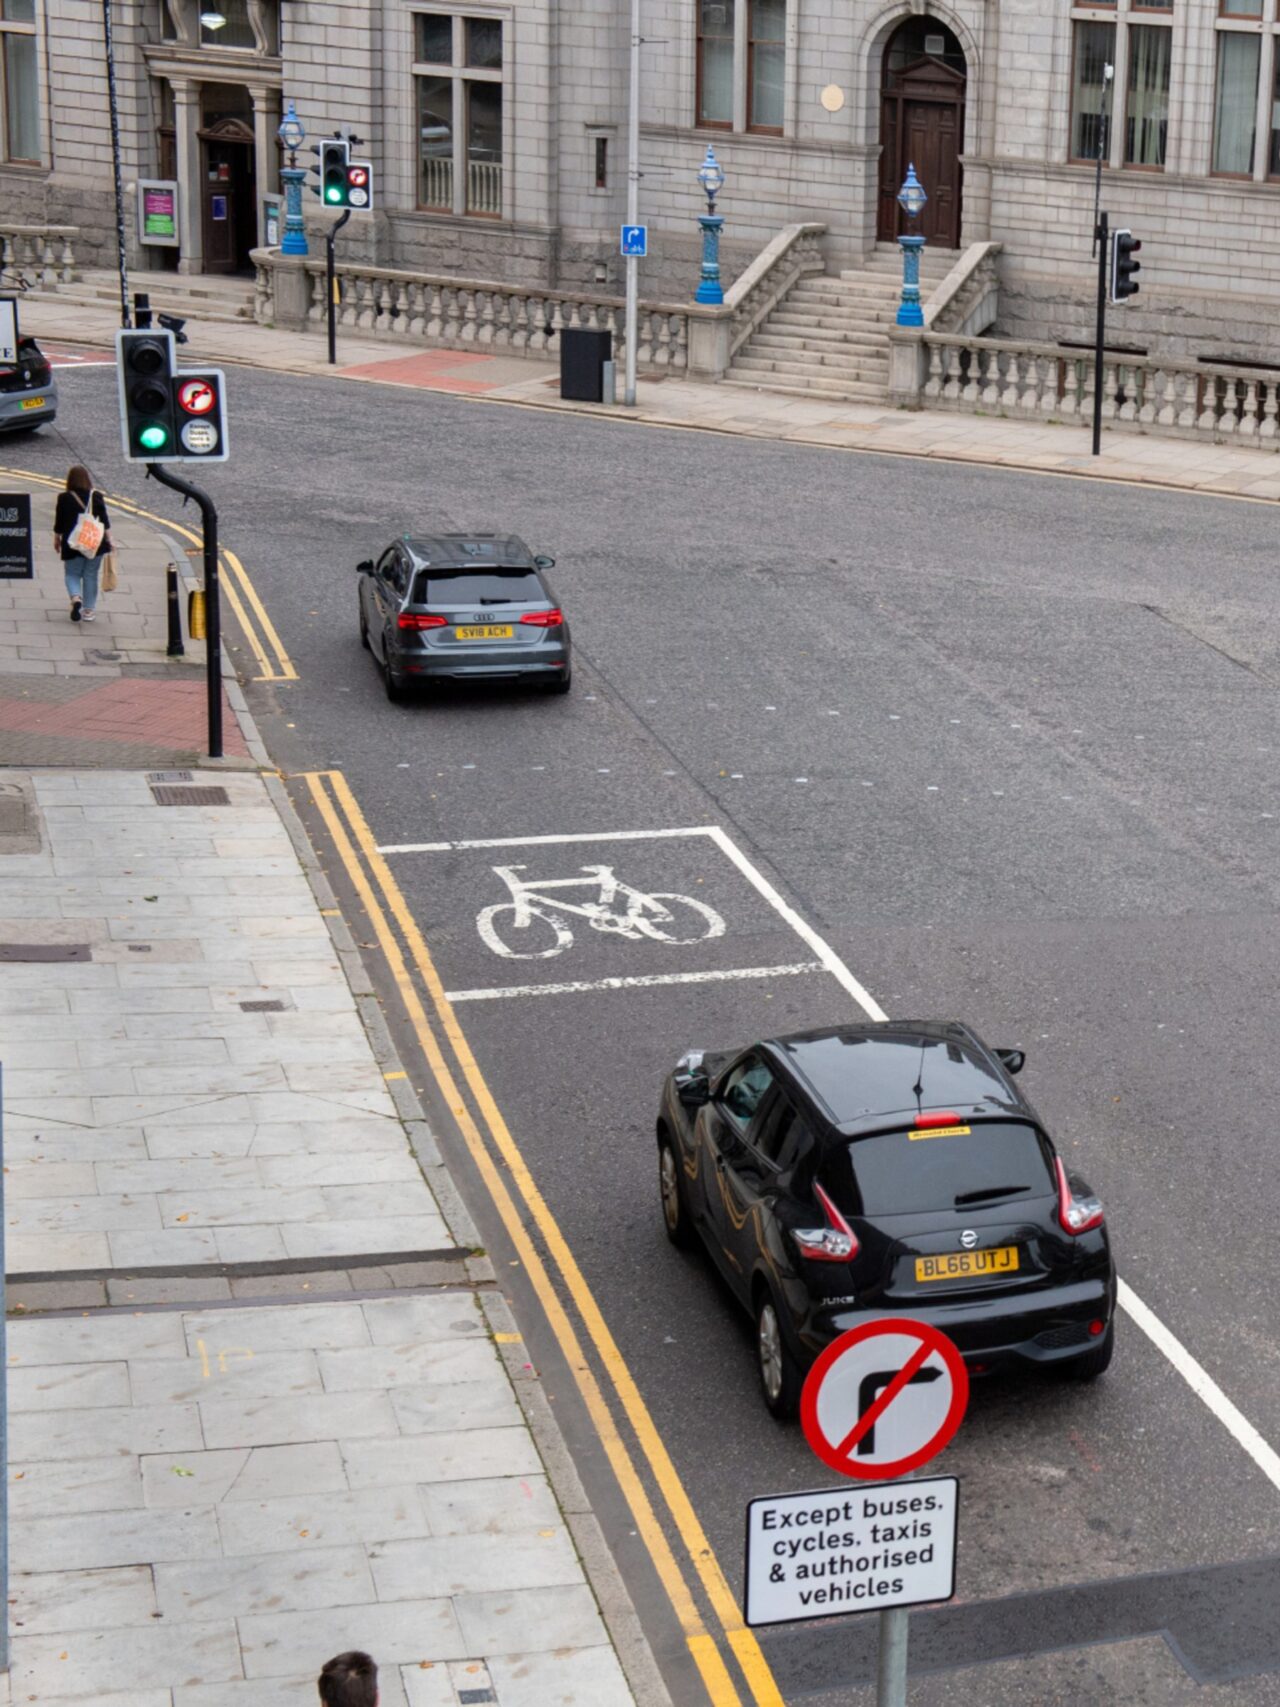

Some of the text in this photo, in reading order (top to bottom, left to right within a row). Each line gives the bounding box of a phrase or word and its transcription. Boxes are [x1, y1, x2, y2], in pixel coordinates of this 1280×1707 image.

[923, 1249, 1010, 1277] BL66 UTJ
[762, 1501, 853, 1531] Except
[871, 1519, 932, 1544] taxis
[769, 1543, 934, 1584] & authorised
[799, 1577, 904, 1605] vehicles
